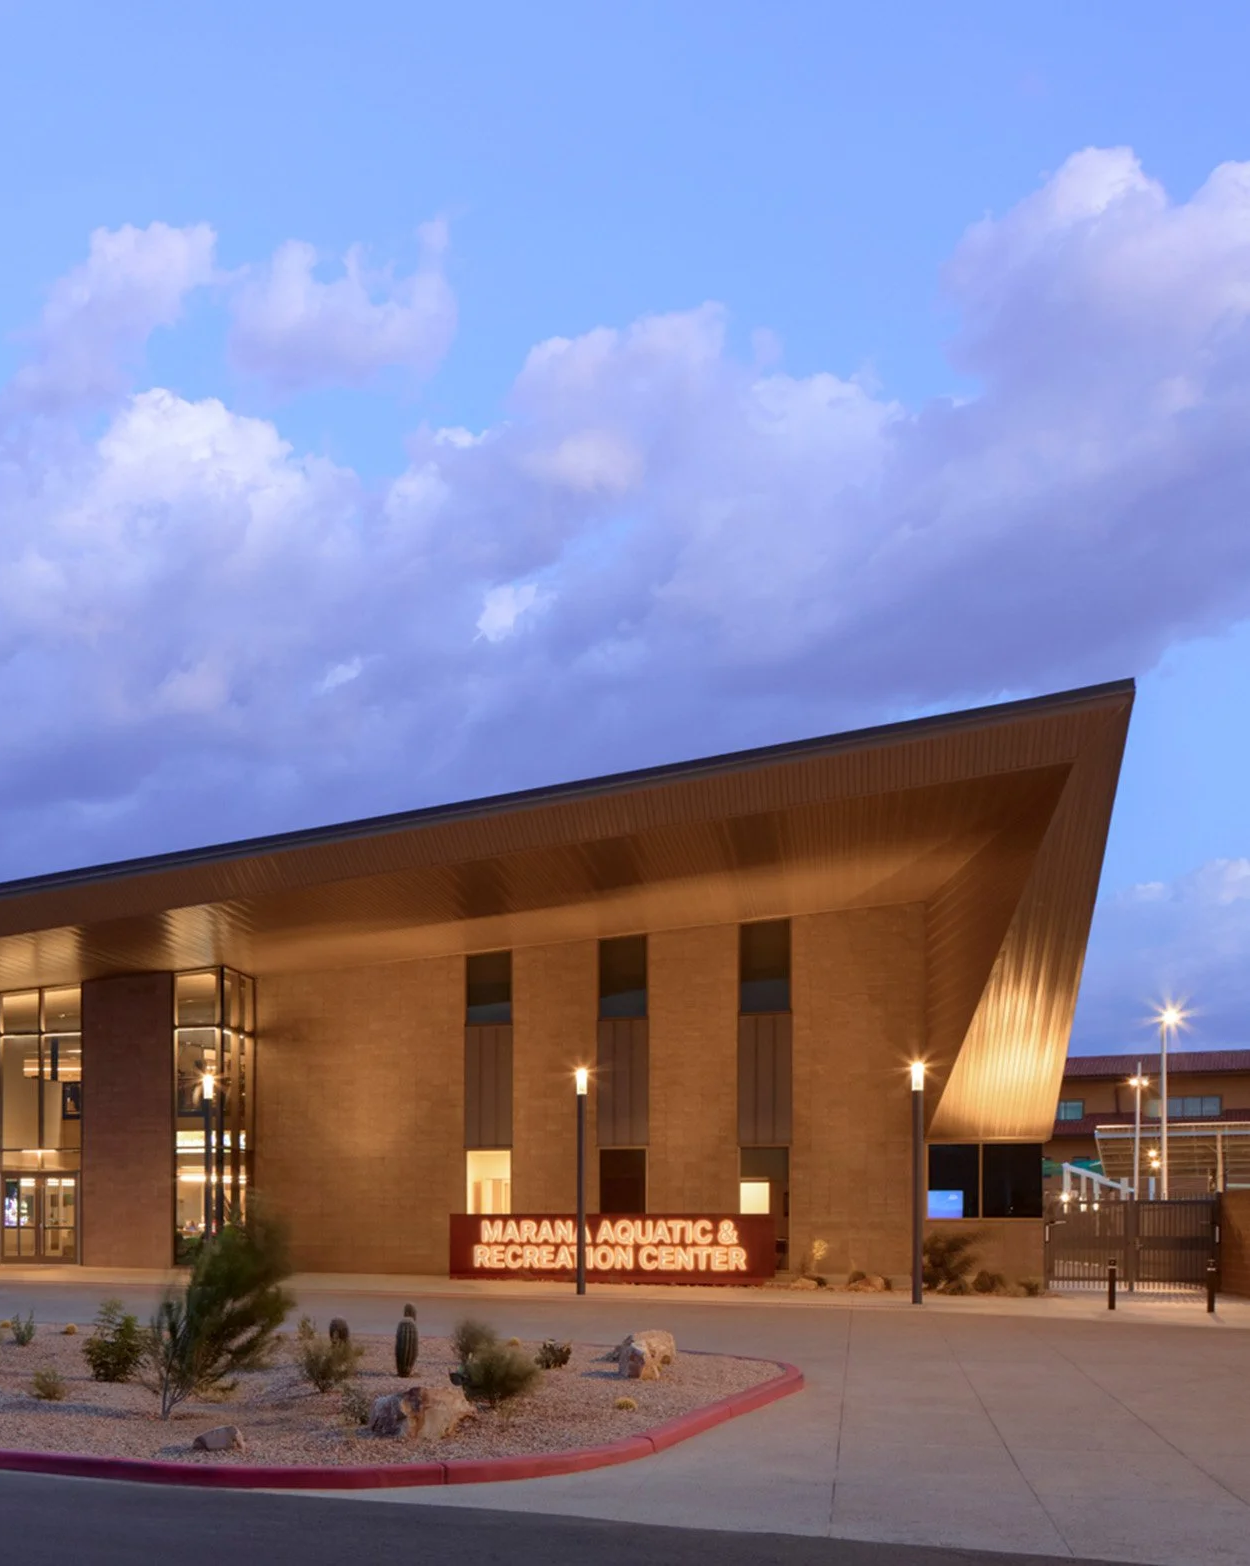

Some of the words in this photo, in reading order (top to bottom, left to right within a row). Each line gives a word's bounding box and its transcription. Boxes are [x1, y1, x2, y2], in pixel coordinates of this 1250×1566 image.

[480, 1219, 593, 1244] MARANA
[595, 1219, 714, 1246] AQUATIC
[717, 1219, 739, 1245] &
[473, 1244, 635, 1270] RECREATION
[638, 1245, 748, 1271] CENTER
